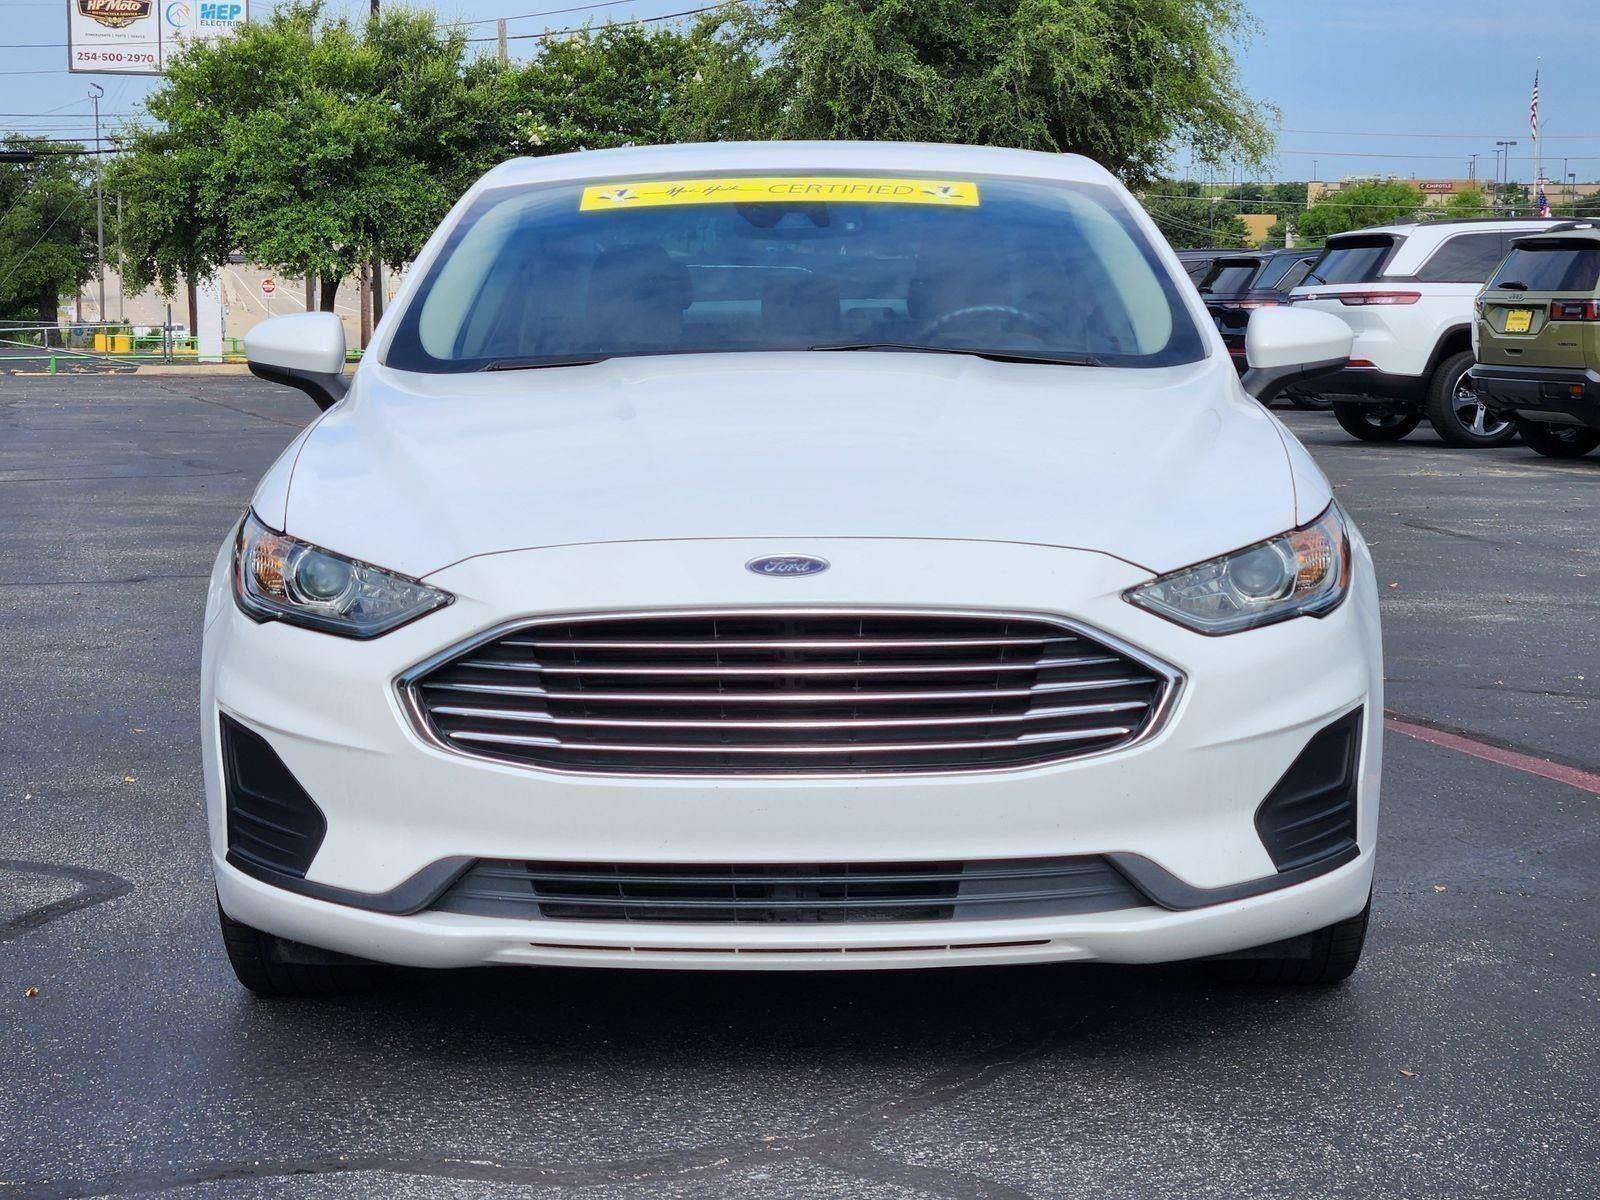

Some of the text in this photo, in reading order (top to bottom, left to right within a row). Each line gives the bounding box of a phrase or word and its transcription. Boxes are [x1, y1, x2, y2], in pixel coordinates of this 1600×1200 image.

[87, 0, 142, 11] HP Moto
[201, 4, 241, 20] MEP
[77, 52, 154, 63] 254-500-2970
[768, 183, 914, 195] CERTIFIED
[764, 560, 809, 572] Ford
